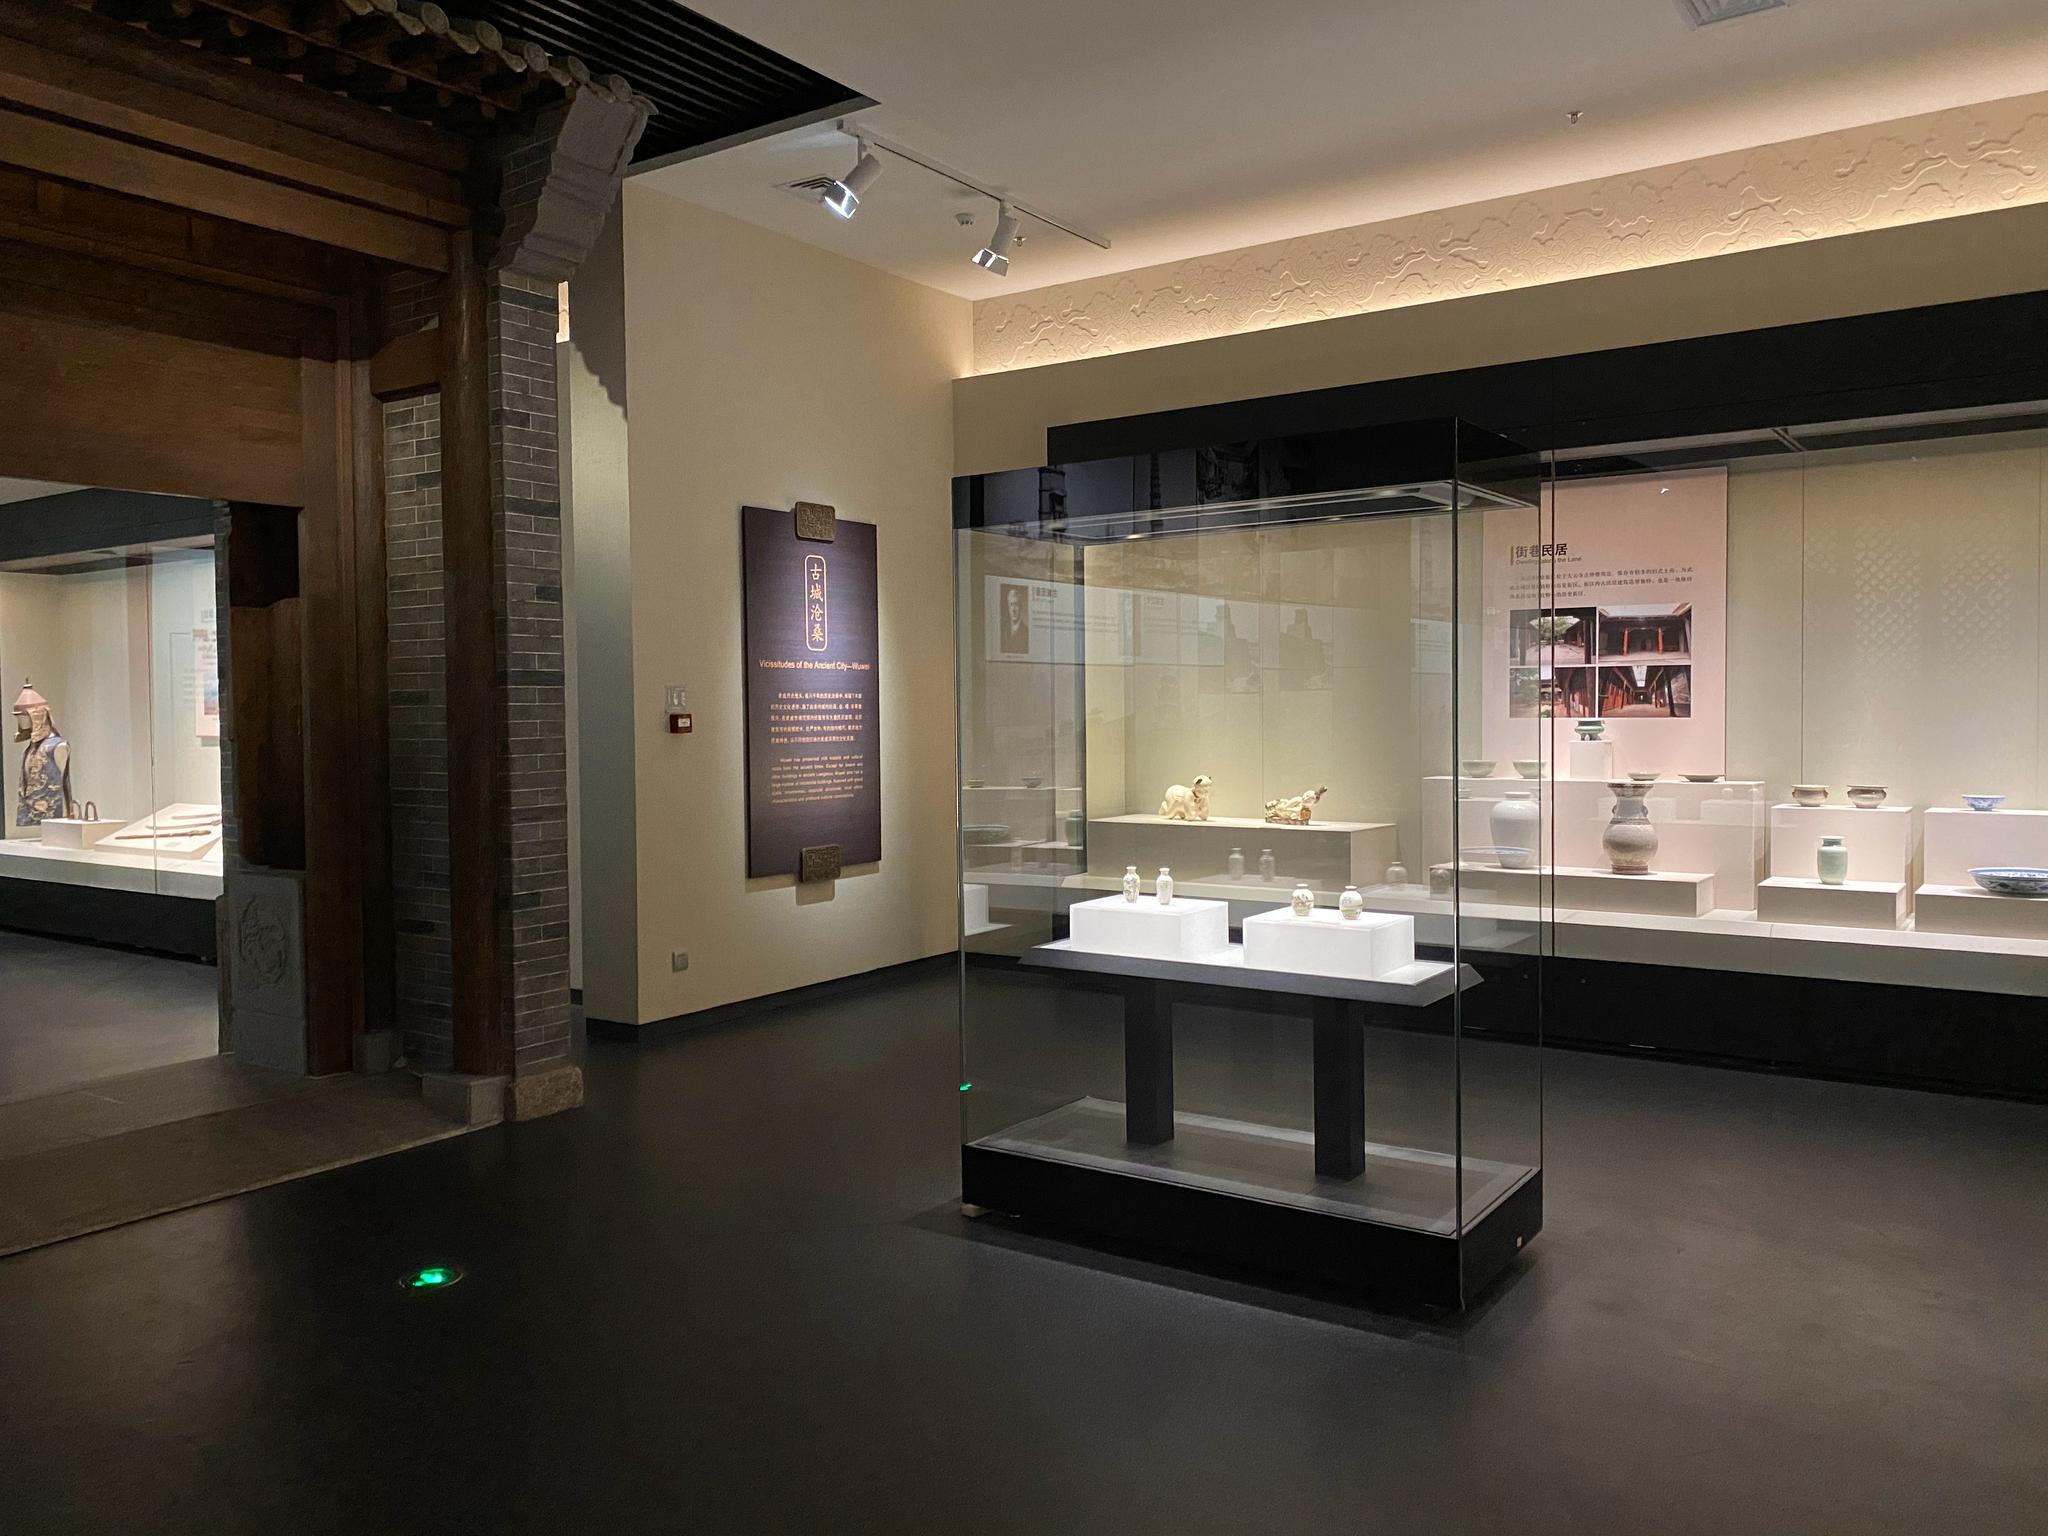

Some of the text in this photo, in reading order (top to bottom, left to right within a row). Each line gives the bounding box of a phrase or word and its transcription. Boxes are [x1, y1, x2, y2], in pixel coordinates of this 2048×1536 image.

[1515, 543, 1568, 558] 街巷民居
[809, 563, 824, 642] 古城沧桑
[759, 659, 795, 669] Vicissitudes
[796, 660, 802, 669] of
[803, 660, 813, 669] the
[814, 661, 836, 670] Ancient
